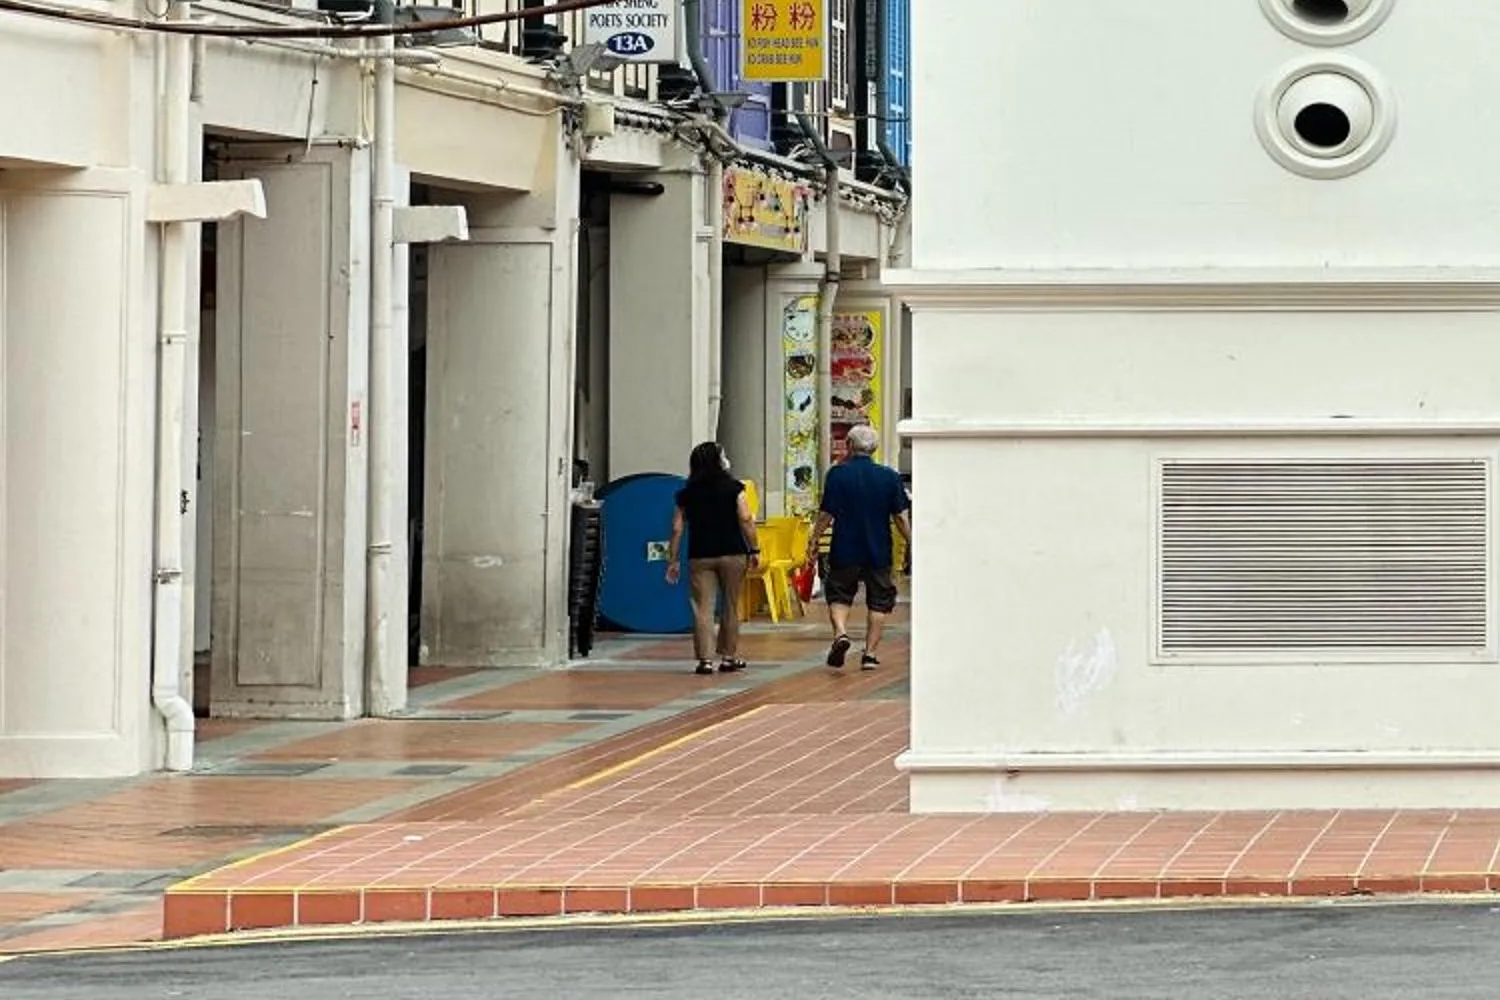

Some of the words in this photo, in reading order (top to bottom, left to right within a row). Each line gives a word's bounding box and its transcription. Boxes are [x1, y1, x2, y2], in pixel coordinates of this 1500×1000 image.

[590, 13, 622, 29] POETS
[625, 13, 668, 29] SOCIETY
[612, 35, 648, 51] 13A
